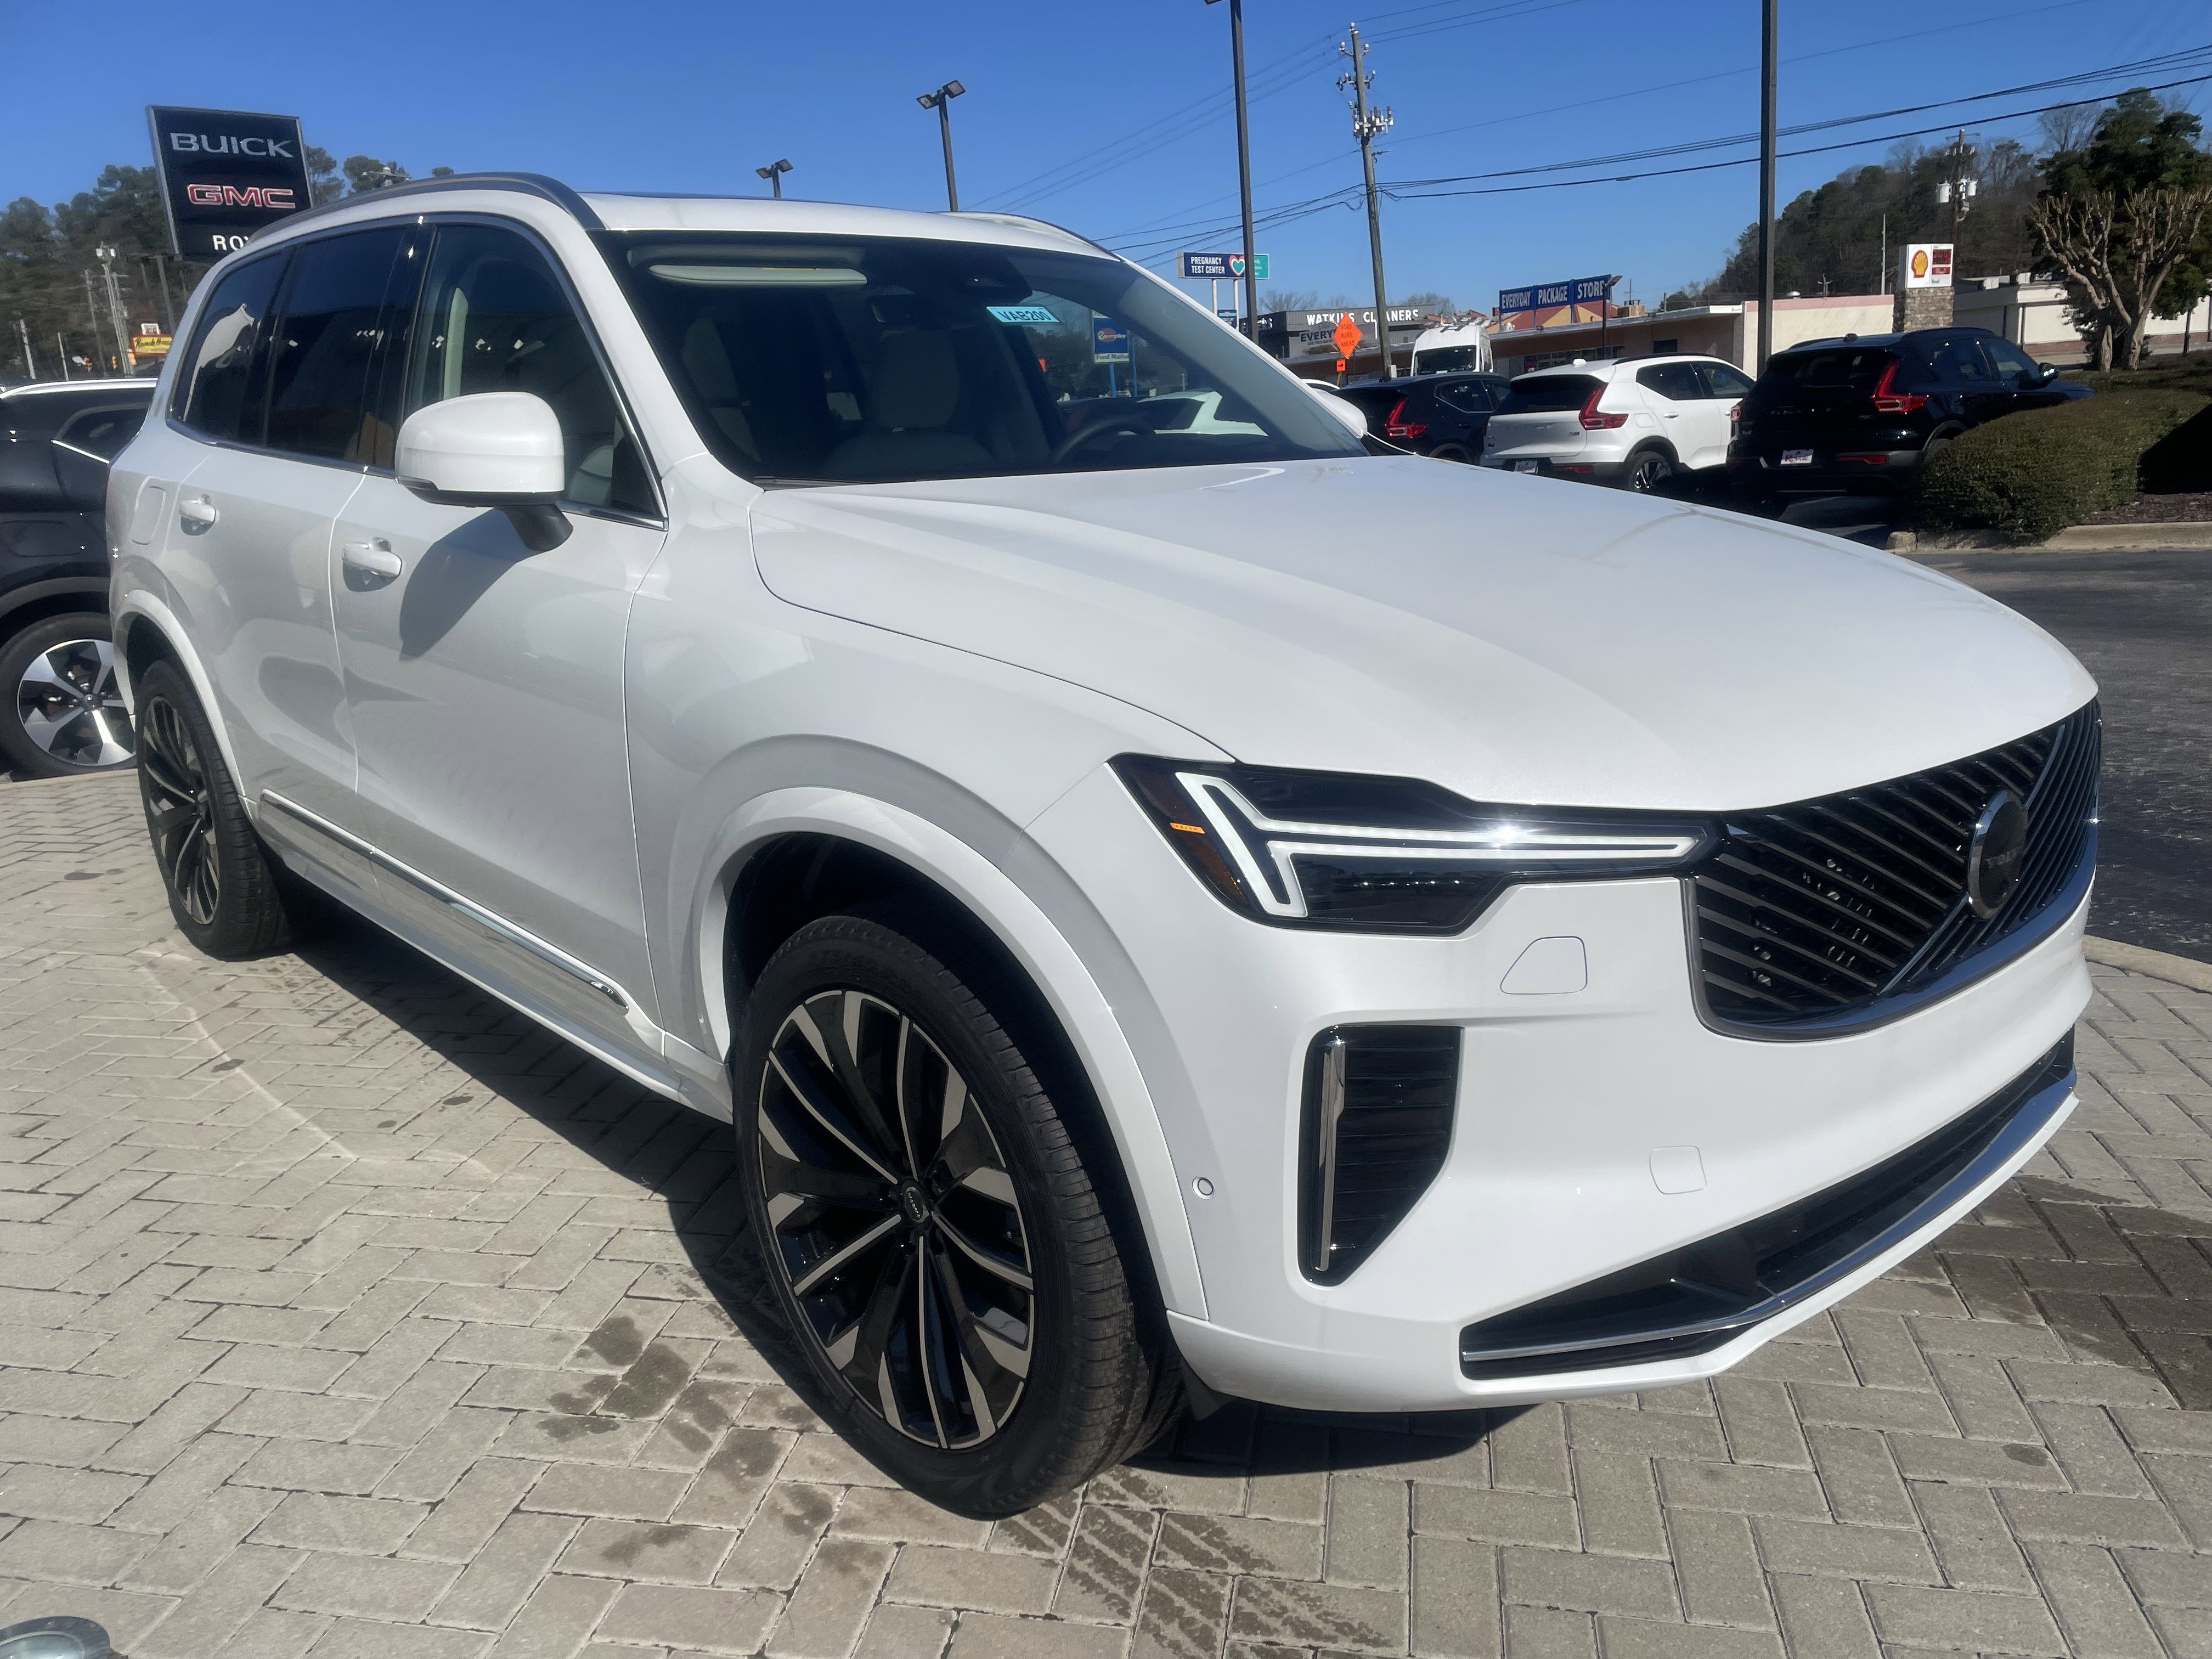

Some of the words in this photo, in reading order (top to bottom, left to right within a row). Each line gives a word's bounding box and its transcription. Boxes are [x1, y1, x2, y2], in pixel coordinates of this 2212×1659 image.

[170, 132, 295, 158] BUICK
[187, 184, 296, 209] GMC
[212, 234, 249, 251] RO
[1190, 256, 1222, 265] PREGNANCY
[1191, 266, 1204, 274] TEST
[1205, 266, 1226, 274] CENTER
[1502, 291, 1531, 309] EVERYDAY
[1538, 285, 1568, 305] PACKAGE
[1577, 280, 1605, 300] STORE
[996, 311, 1052, 321] VAB200
[1363, 309, 1419, 323] CLNERS
[1300, 330, 1336, 342] EVERY
